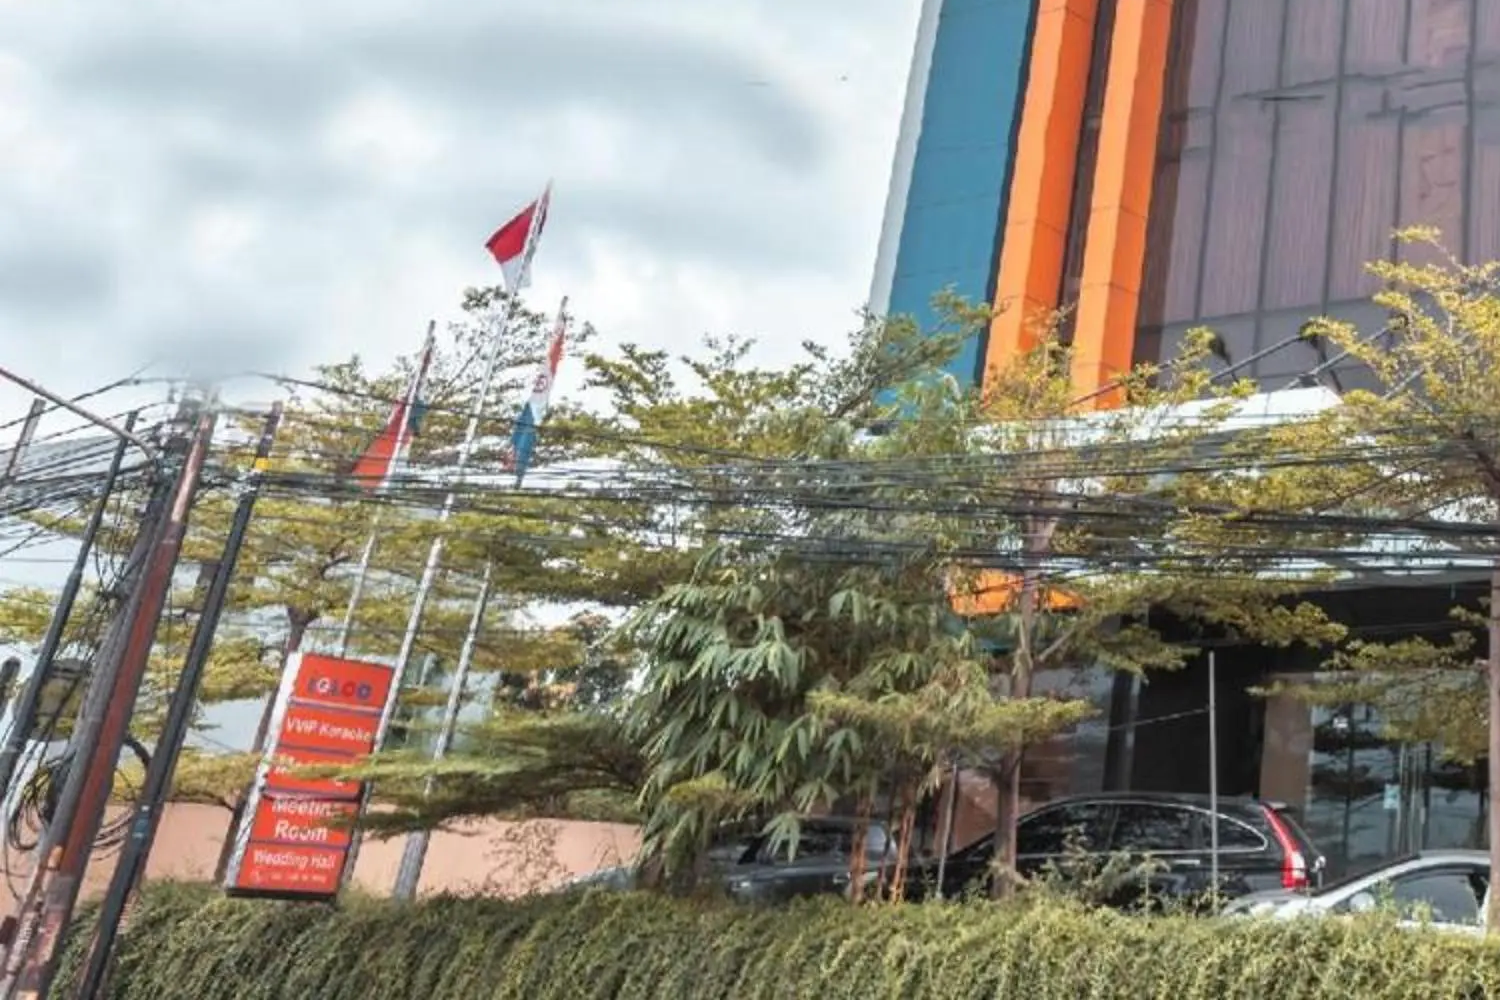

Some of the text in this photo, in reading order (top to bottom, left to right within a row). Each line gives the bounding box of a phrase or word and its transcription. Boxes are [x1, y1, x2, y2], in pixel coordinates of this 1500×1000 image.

[275, 820, 328, 841] Room
[252, 849, 337, 870] Wedding Hall
